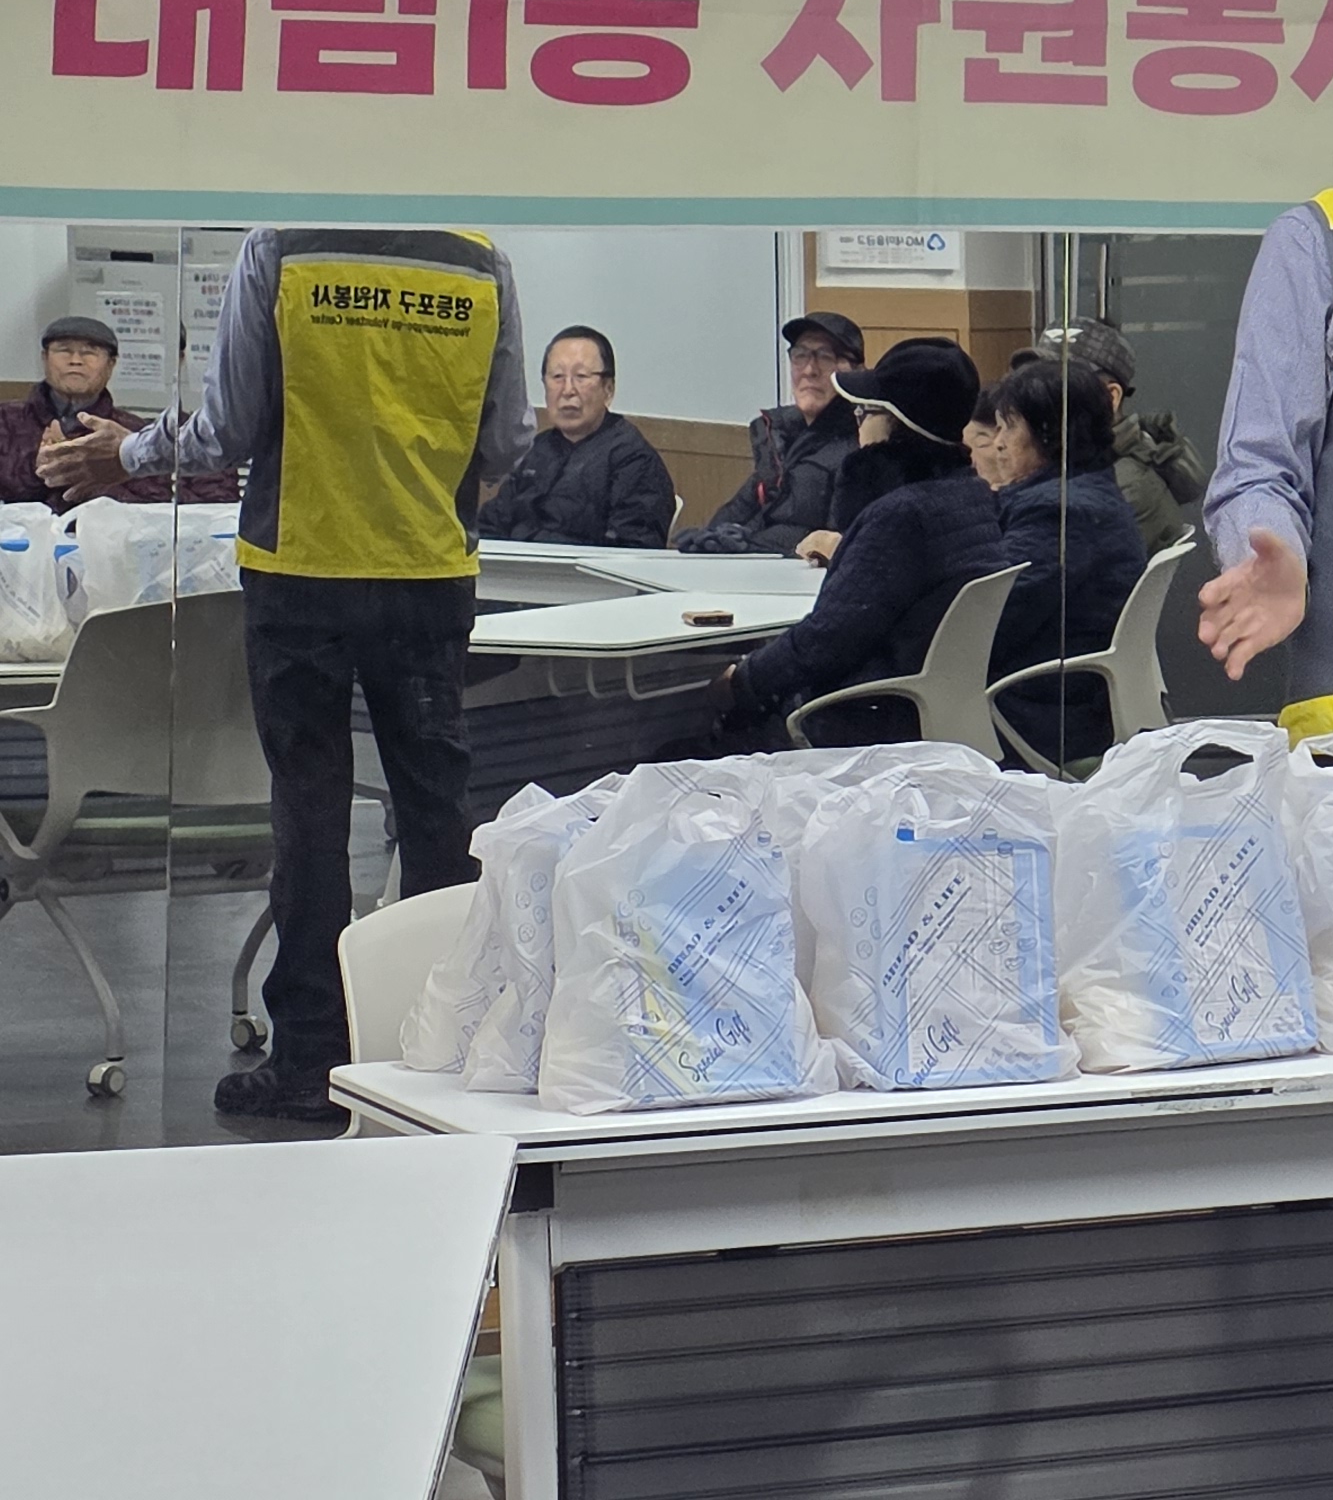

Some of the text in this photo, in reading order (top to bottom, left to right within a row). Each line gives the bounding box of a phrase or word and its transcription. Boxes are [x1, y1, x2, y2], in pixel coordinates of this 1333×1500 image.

[932, 872, 966, 911] LIFE
[1184, 886, 1220, 936] BREAD
[1228, 834, 1260, 871] LIFE
[667, 932, 702, 975] BREAD
[717, 876, 750, 914] LIFE
[927, 1014, 965, 1054] Gift
[1204, 966, 1263, 1042] Special Gift
[678, 1009, 752, 1083] Special Gift
